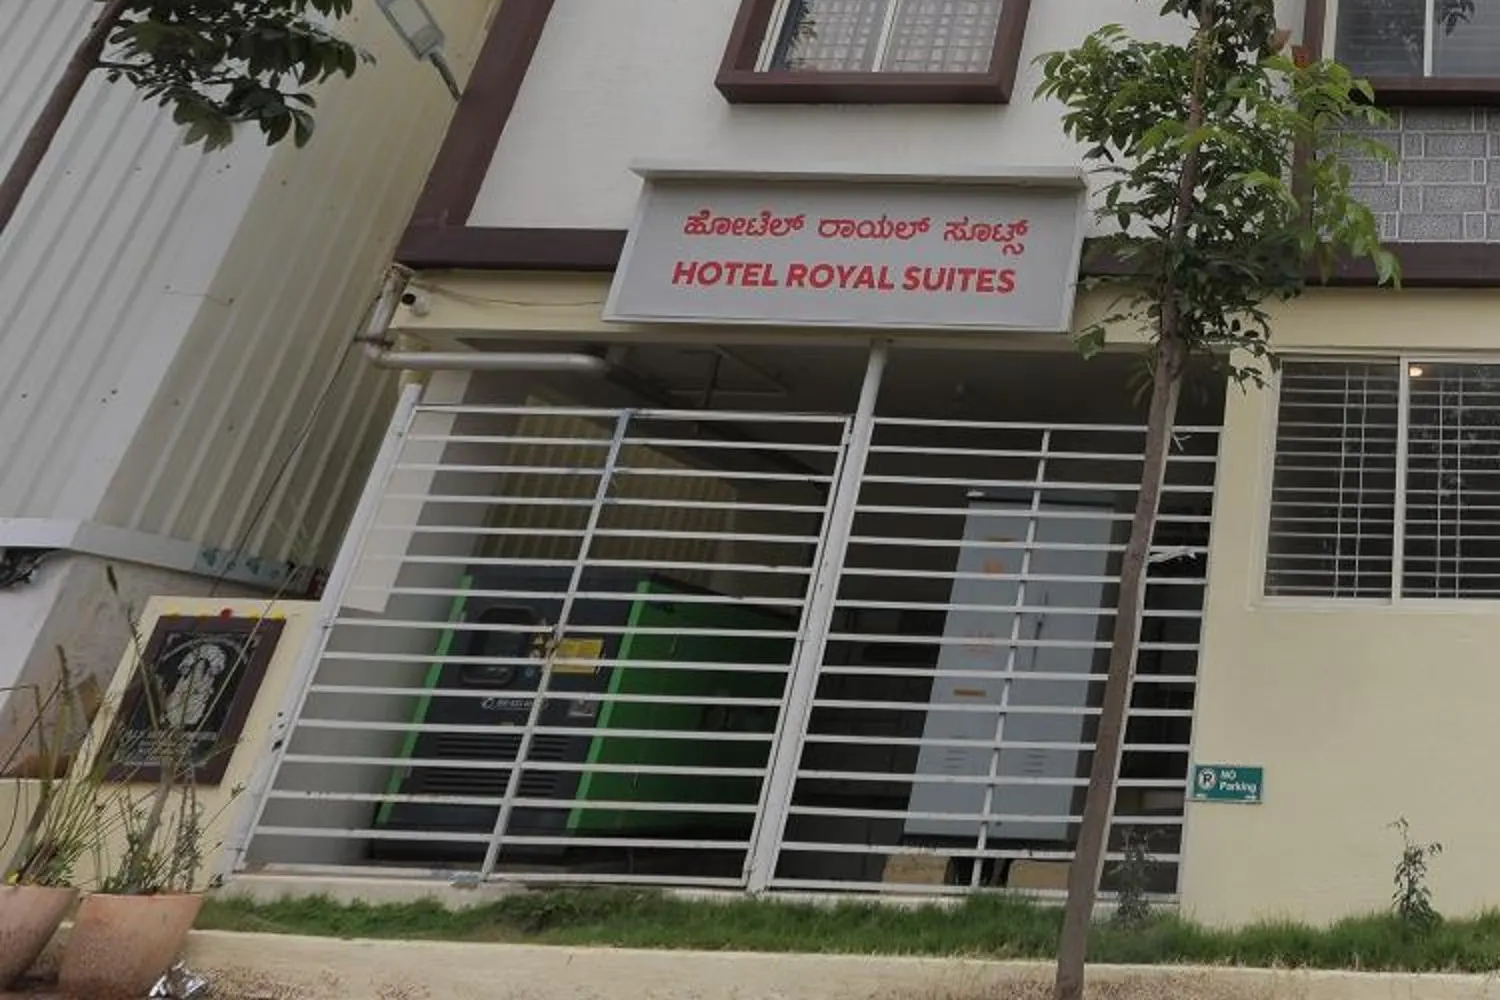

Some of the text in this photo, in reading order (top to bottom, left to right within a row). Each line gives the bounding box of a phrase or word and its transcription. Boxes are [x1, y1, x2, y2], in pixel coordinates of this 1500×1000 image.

[683, 208, 1030, 256] ಹೋಟೆಲ್ ರಾಯಲ್ ಸೂಟ್ಸ್
[671, 260, 1017, 294] HOTEL ROYAL SUITES
[1220, 769, 1237, 780] NO
[1219, 781, 1258, 793] Parking
